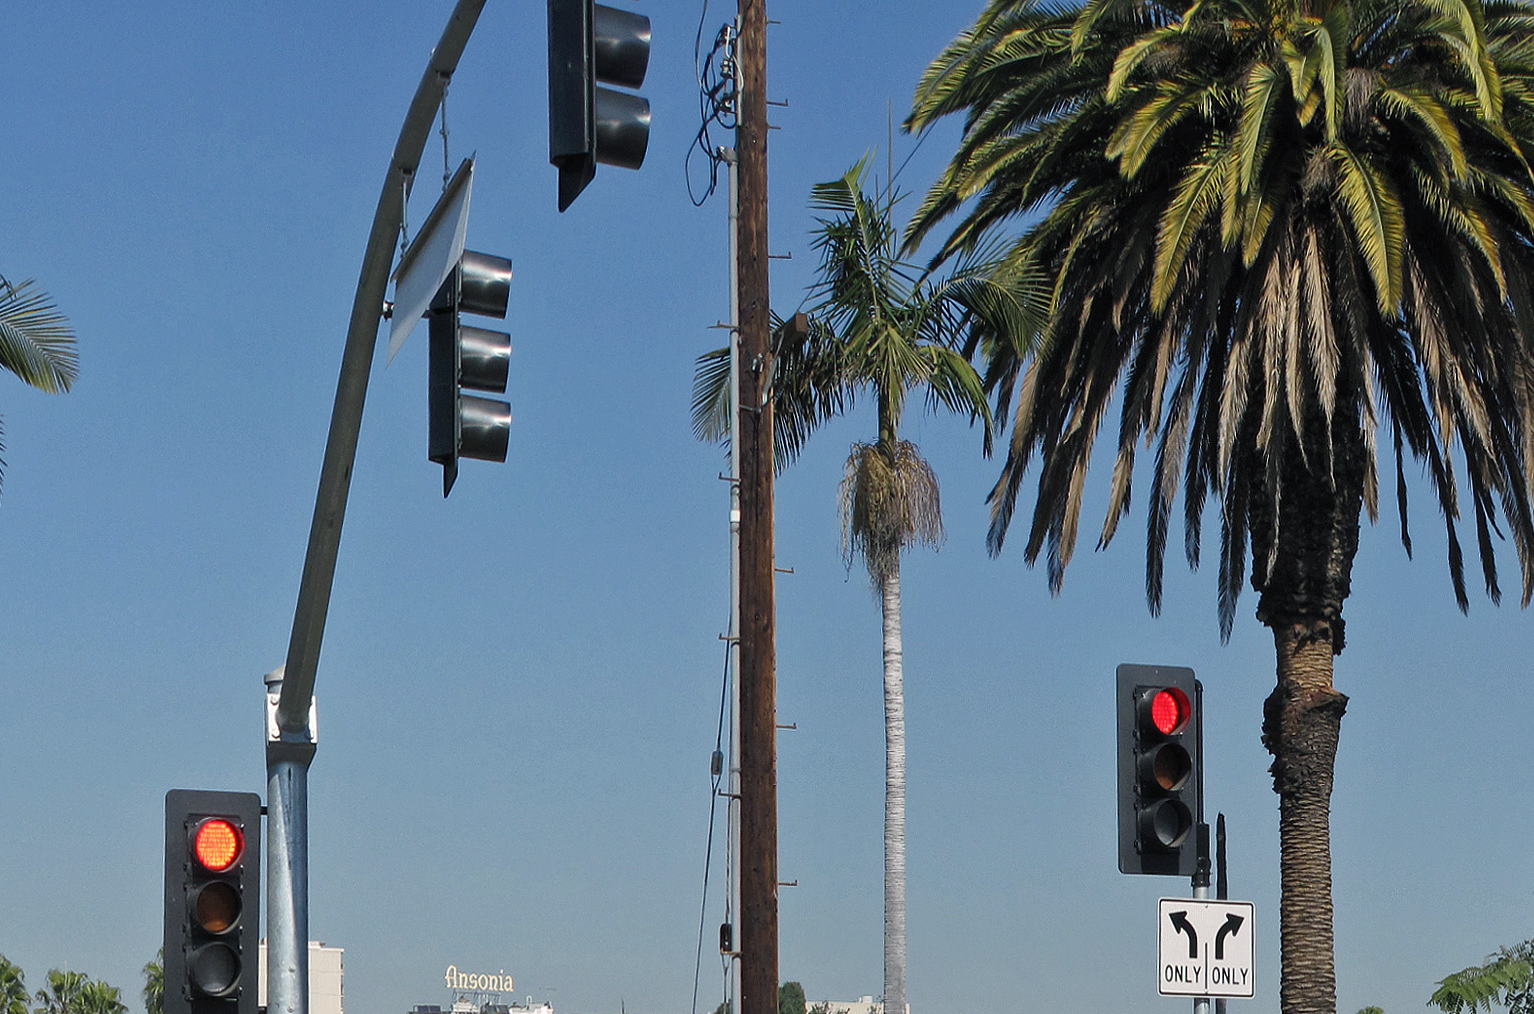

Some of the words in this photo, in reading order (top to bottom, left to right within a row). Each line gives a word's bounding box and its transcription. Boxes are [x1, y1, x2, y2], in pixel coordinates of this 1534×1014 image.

[445, 965, 514, 992] Ansonia
[1165, 965, 1201, 983] ONLY
[1212, 967, 1248, 985] ONLY
